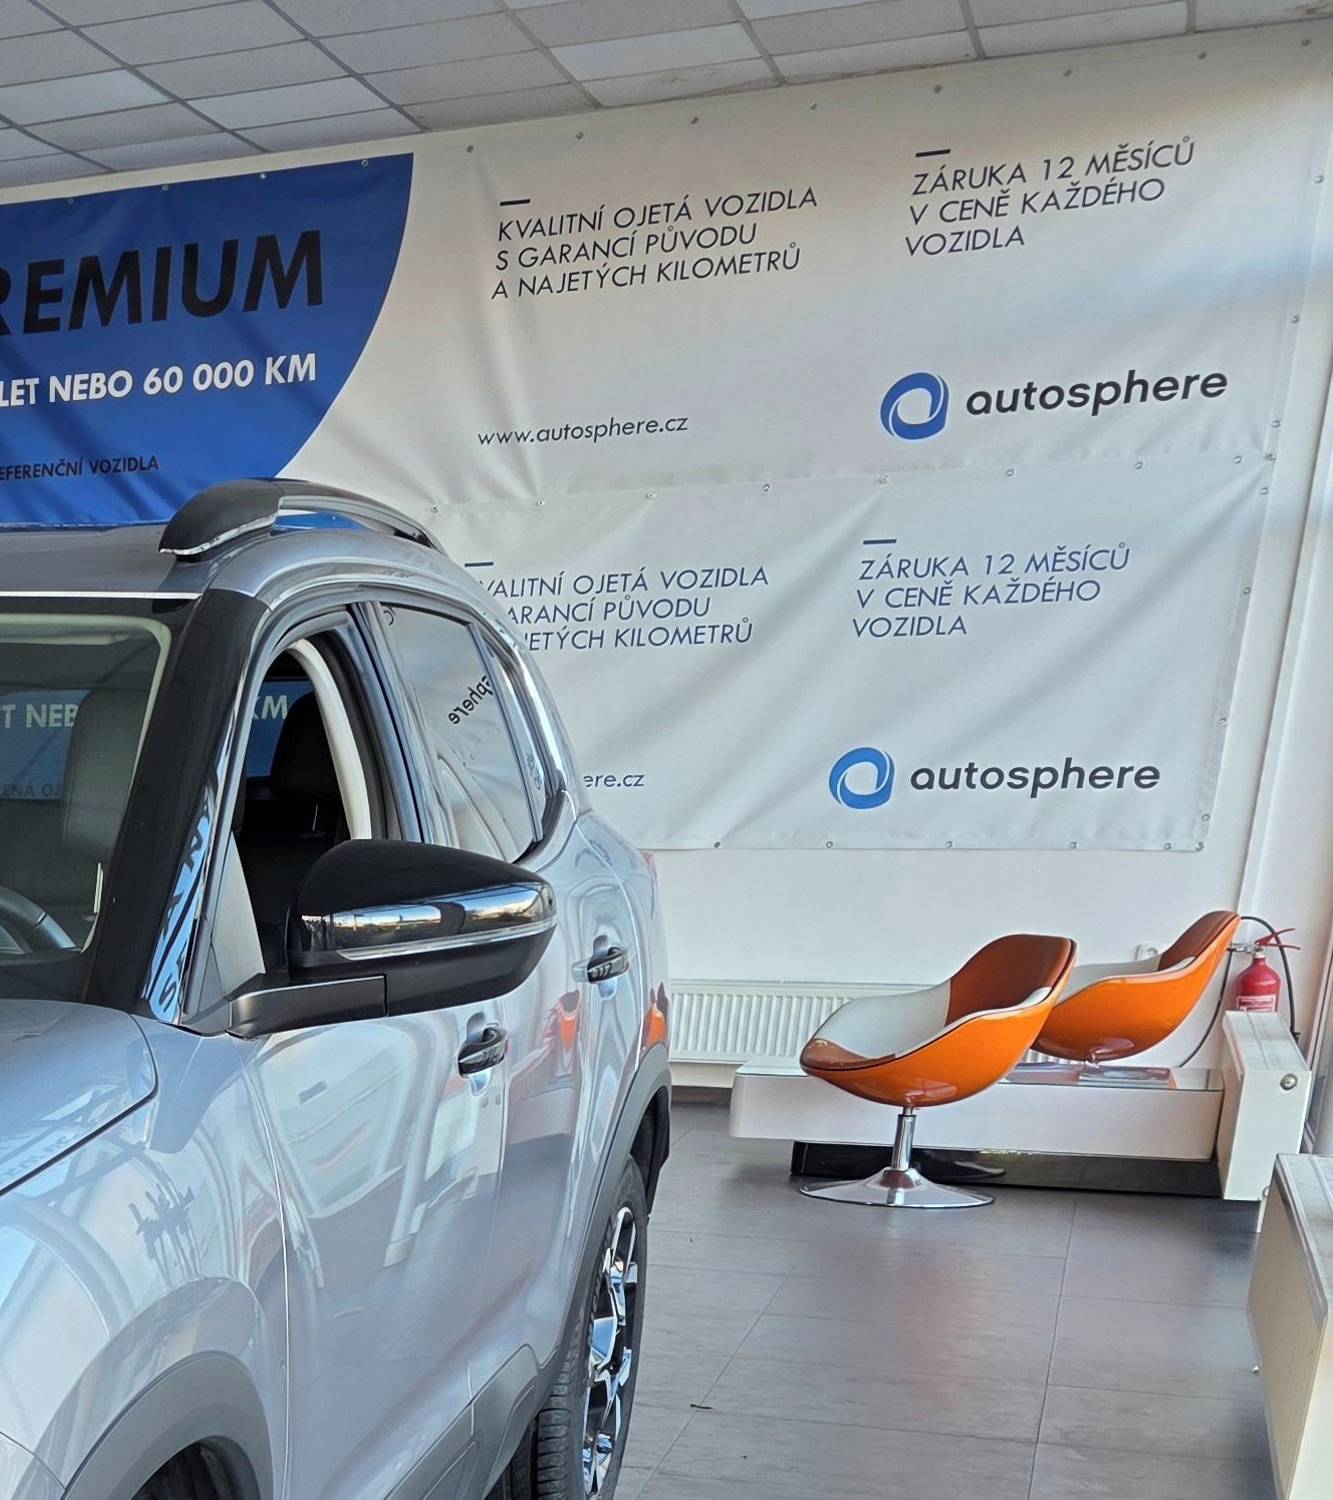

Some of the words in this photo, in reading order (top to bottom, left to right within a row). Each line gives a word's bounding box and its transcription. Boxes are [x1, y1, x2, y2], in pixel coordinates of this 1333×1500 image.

[913, 164, 1026, 196] ZÁRUKA
[1044, 156, 1074, 180] 12
[1085, 136, 1195, 176] MĚSÍCŮ
[499, 205, 605, 241] KVALITNÍ
[614, 195, 692, 229] OJETÁ
[705, 187, 817, 217] VOZIDLA
[910, 204, 927, 225] V
[939, 189, 1009, 222] CENĚ
[1021, 176, 1164, 214] KAŽDÉHO
[496, 251, 508, 270] S
[519, 230, 637, 267] GARANCÍ
[646, 223, 756, 254] PŮVODU
[905, 226, 1025, 256] VOZIDLA
[492, 281, 508, 299] A
[519, 263, 646, 297] NAJETÝCH
[657, 242, 800, 282] KILOMETRŮ
[49, 370, 132, 402] NEBO
[143, 366, 183, 395] 60
[193, 360, 254, 391] 000
[265, 354, 316, 385] KM
[966, 370, 1228, 416] autosphere
[478, 417, 689, 445] www.autosphere.cz
[89, 456, 158, 475] VOZIDLA
[859, 553, 969, 580] ZÁRUKA
[985, 554, 1014, 575] 12
[1025, 542, 1130, 573] MĚSÍCŮ
[573, 567, 648, 596] OJETÁ
[661, 566, 769, 590] VOZIDLA
[857, 589, 874, 608] V
[885, 580, 953, 608] CENĚ
[964, 577, 1100, 605] KAŽDÉHO
[604, 594, 710, 621] PŮVODU
[615, 617, 753, 648] KILOMETRŮ
[853, 616, 967, 638] VOZIDLA
[911, 757, 1160, 798] autosphere
